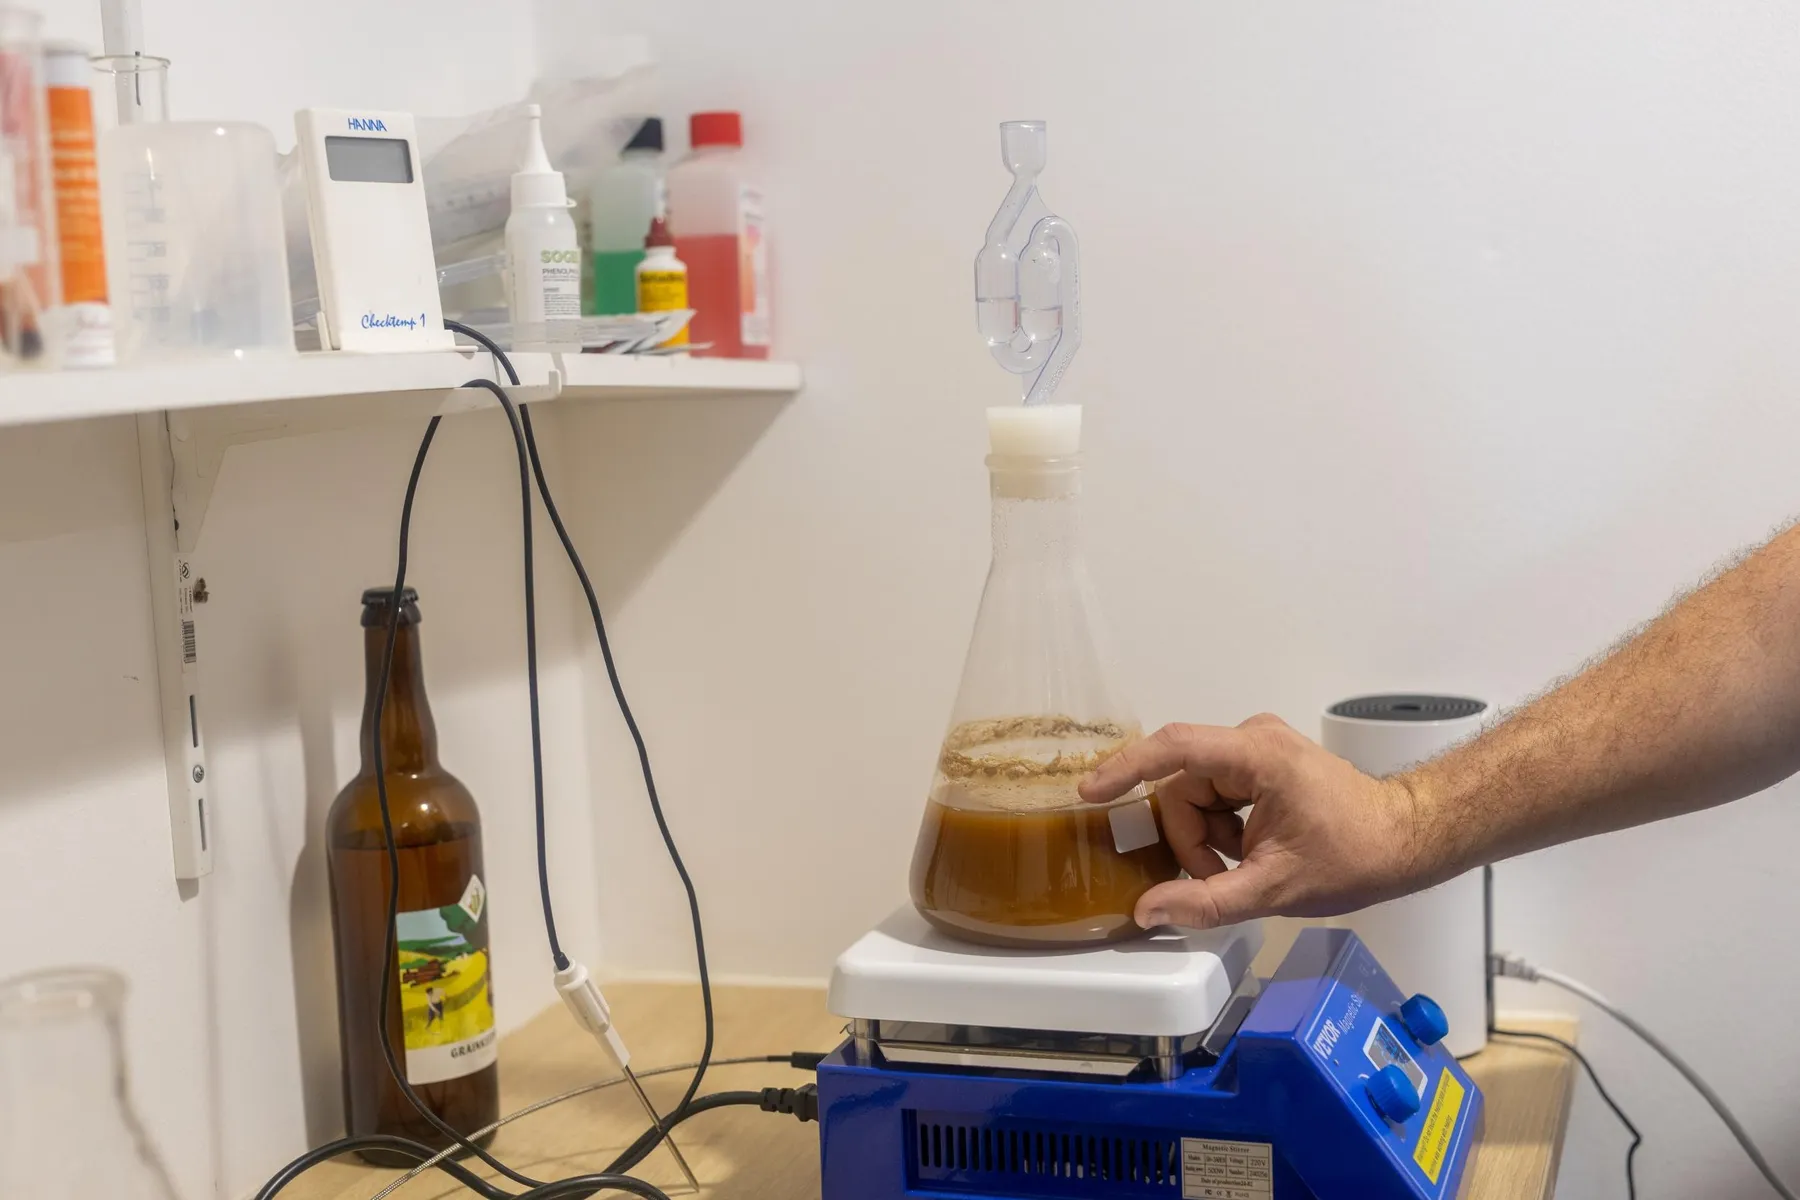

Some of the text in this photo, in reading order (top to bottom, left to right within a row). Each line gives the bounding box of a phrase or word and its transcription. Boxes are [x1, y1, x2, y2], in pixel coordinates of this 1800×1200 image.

[348, 118, 388, 132] HANNA
[361, 313, 426, 331] Checktemp 1
[1338, 1002, 1358, 1035] Magnetic
[1313, 1018, 1341, 1060] VEVOR
[1202, 1143, 1250, 1153] Magnetic Stirrer
